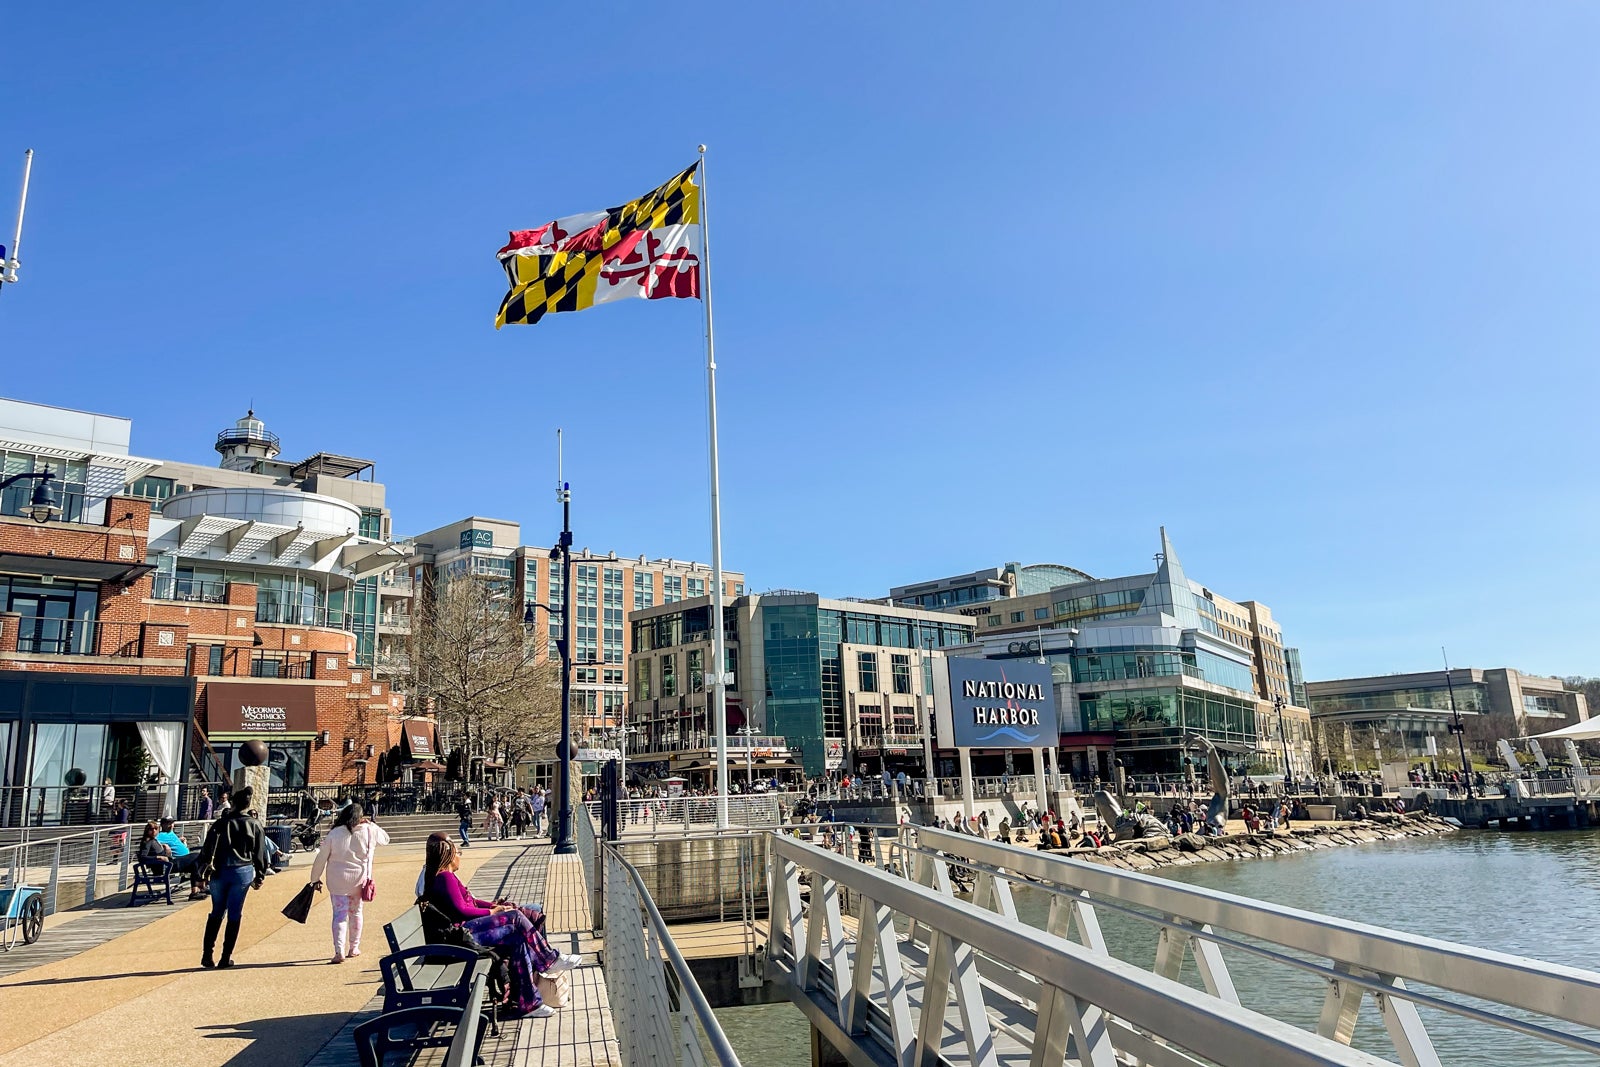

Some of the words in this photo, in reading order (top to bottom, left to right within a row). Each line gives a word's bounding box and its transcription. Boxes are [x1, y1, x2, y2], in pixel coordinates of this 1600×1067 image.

[475, 532, 491, 541] AC
[959, 606, 991, 616] WESTIN
[1008, 639, 1041, 655] CACI
[963, 680, 1045, 700] NATIONAL
[974, 707, 1040, 725] HARBOR
